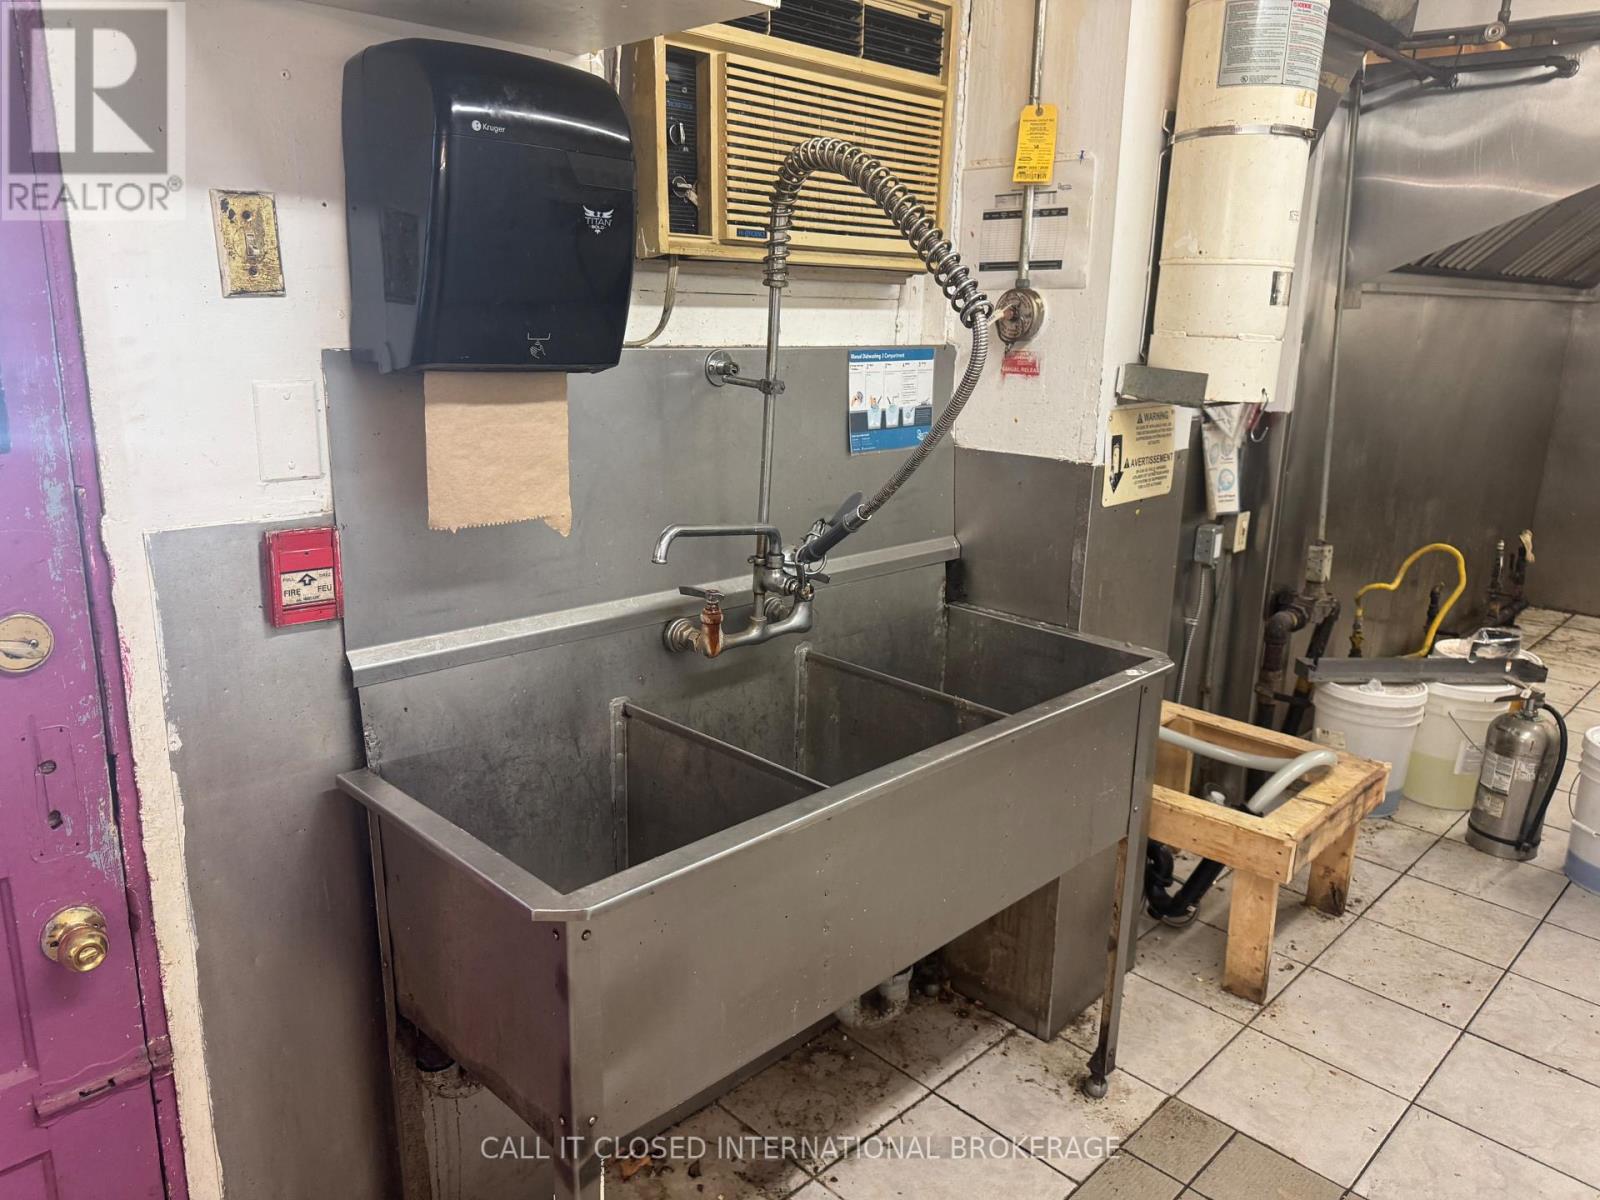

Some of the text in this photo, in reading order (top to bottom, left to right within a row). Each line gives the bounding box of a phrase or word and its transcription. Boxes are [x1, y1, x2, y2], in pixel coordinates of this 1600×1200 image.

[482, 122, 506, 134] Kruger
[584, 216, 612, 227] TITAN
[1144, 411, 1169, 422] WARNING
[1131, 452, 1173, 467] AVERTISSEMENT
[283, 589, 301, 597] FIRE
[317, 584, 332, 592] FEU
